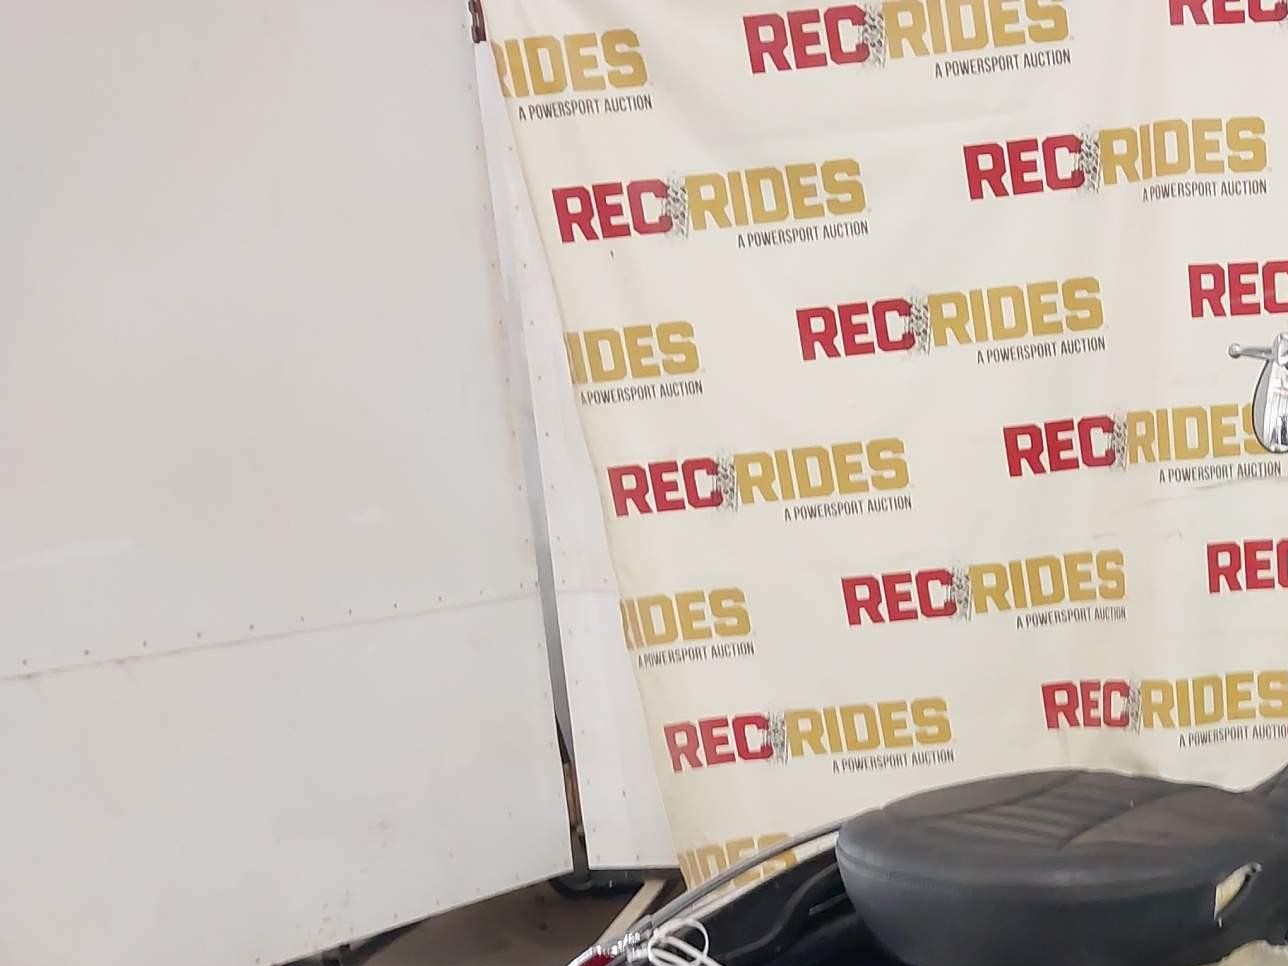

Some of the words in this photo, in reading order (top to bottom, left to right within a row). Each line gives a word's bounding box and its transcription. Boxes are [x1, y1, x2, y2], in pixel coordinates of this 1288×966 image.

[743, 5, 868, 74] REC
[884, 0, 1070, 60] RIDES
[934, 61, 943, 79] A
[945, 53, 1020, 78] POWERSPORT
[1024, 48, 1072, 70] AUCTION
[518, 105, 527, 121] A
[528, 98, 600, 121] POWERSPORT
[605, 93, 653, 113] AUCTION
[963, 134, 1086, 200] REC
[1100, 116, 1267, 186] RIDES
[552, 178, 670, 244] REC
[685, 158, 867, 231] RIDES
[1143, 187, 1149, 203] A
[1149, 181, 1217, 202] POWERSPORT
[1221, 178, 1268, 197] AUCTION
[737, 232, 746, 248] A
[747, 225, 819, 247] POWERSPORT
[823, 219, 869, 241] AUCTION
[796, 299, 917, 361] REC
[927, 277, 1105, 348] RIDES
[563, 321, 701, 385] IDES
[978, 349, 985, 365] A
[987, 342, 1057, 364] POWERSPORT
[1061, 335, 1106, 356] AUCTION
[580, 391, 588, 406] A
[660, 379, 705, 399] AUCTION
[1003, 415, 1117, 478] REC
[609, 457, 724, 516] REC
[733, 438, 910, 505] RIDES
[1159, 468, 1166, 484] A
[1168, 463, 1234, 483] POWERSPORT
[1237, 460, 1282, 479] AUCTION
[784, 508, 792, 522] A
[793, 499, 864, 521] POWERSPORT
[867, 495, 913, 513] AUCTION
[841, 567, 957, 626] REC
[968, 549, 1127, 615] RIDES
[1016, 615, 1024, 630] A
[1094, 606, 1127, 622] AUCTION
[711, 641, 755, 660] AUCTION
[1041, 679, 1131, 731] REC
[663, 714, 774, 772] REC
[784, 696, 953, 758] RIDES
[1179, 733, 1186, 748] A
[832, 760, 840, 774] A
[912, 749, 955, 767] AUCTION
